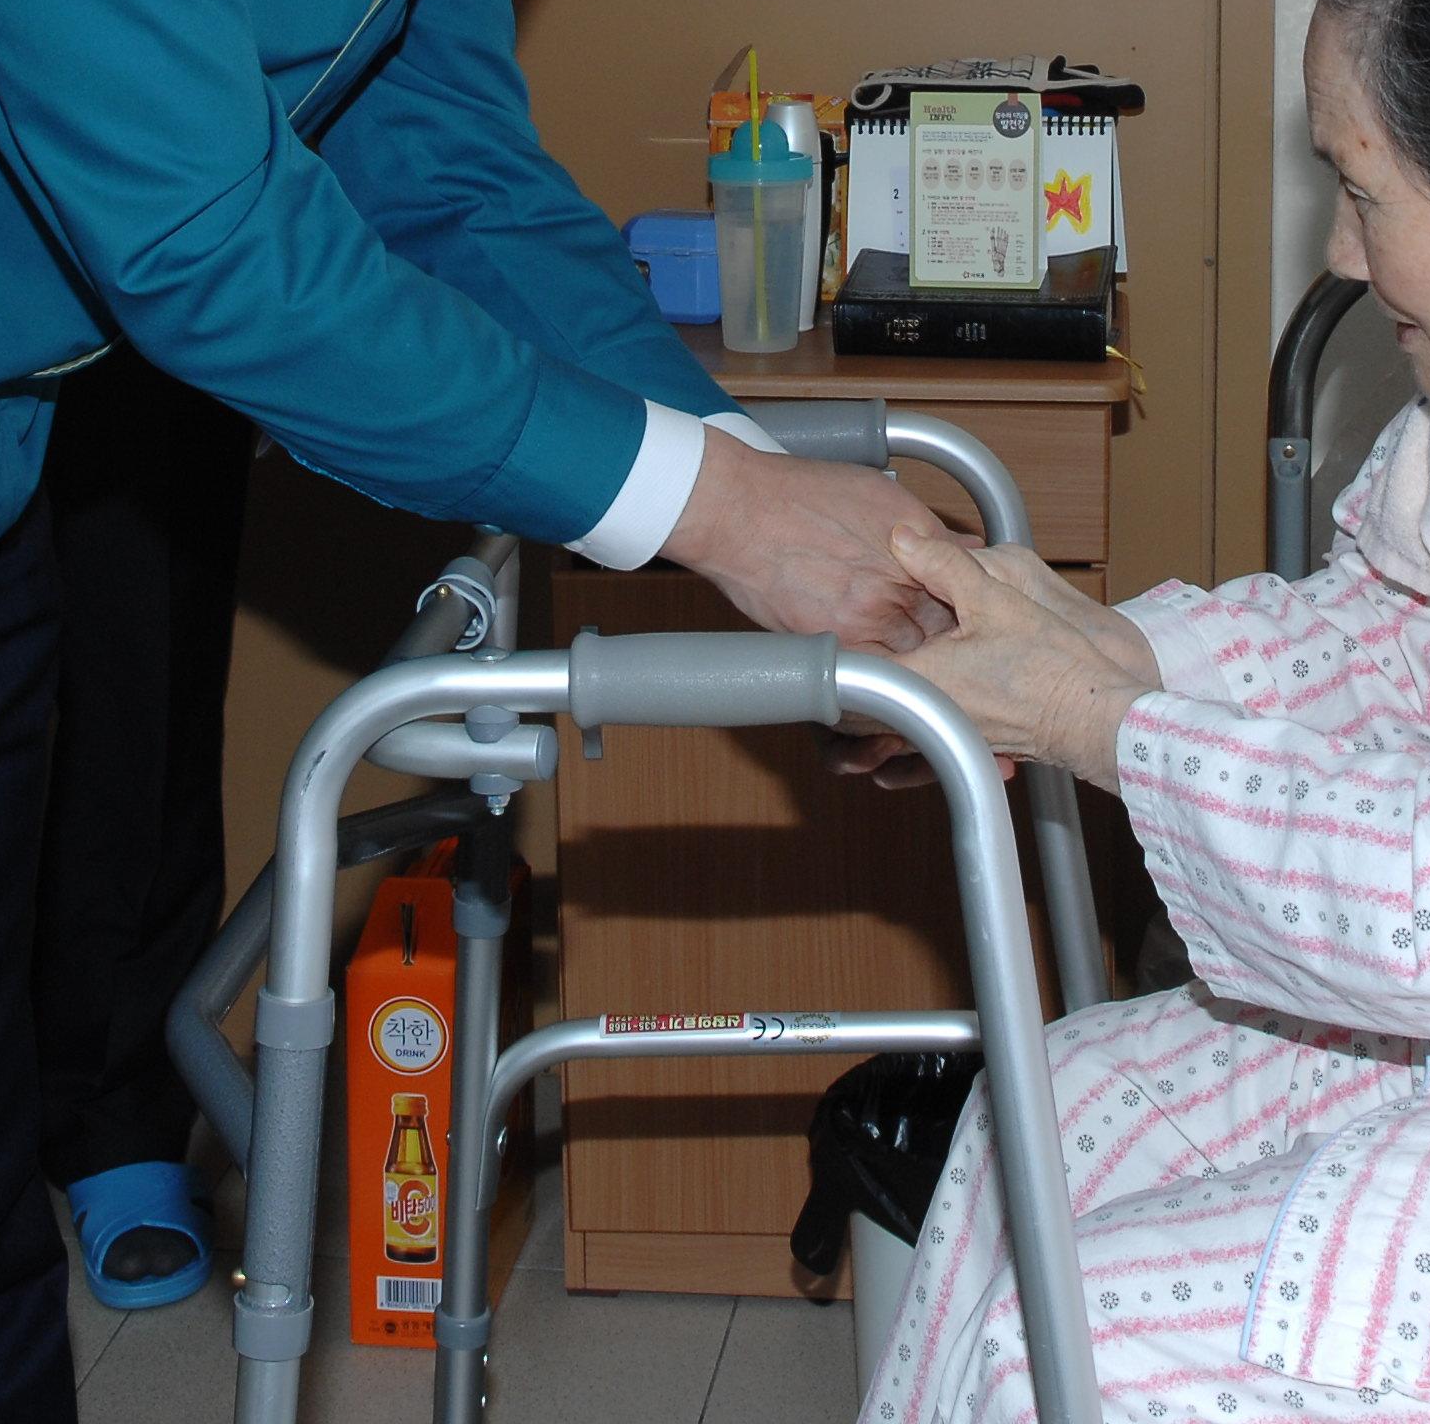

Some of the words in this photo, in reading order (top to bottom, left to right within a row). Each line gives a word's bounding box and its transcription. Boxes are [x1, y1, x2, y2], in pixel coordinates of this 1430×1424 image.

[923, 105, 957, 114] Health
[1000, 119, 1025, 130] 발건강
[893, 188, 899, 200] 2
[385, 1017, 435, 1047] 착한
[753, 1017, 785, 1041] CE
[395, 1048, 426, 1059] DRINK
